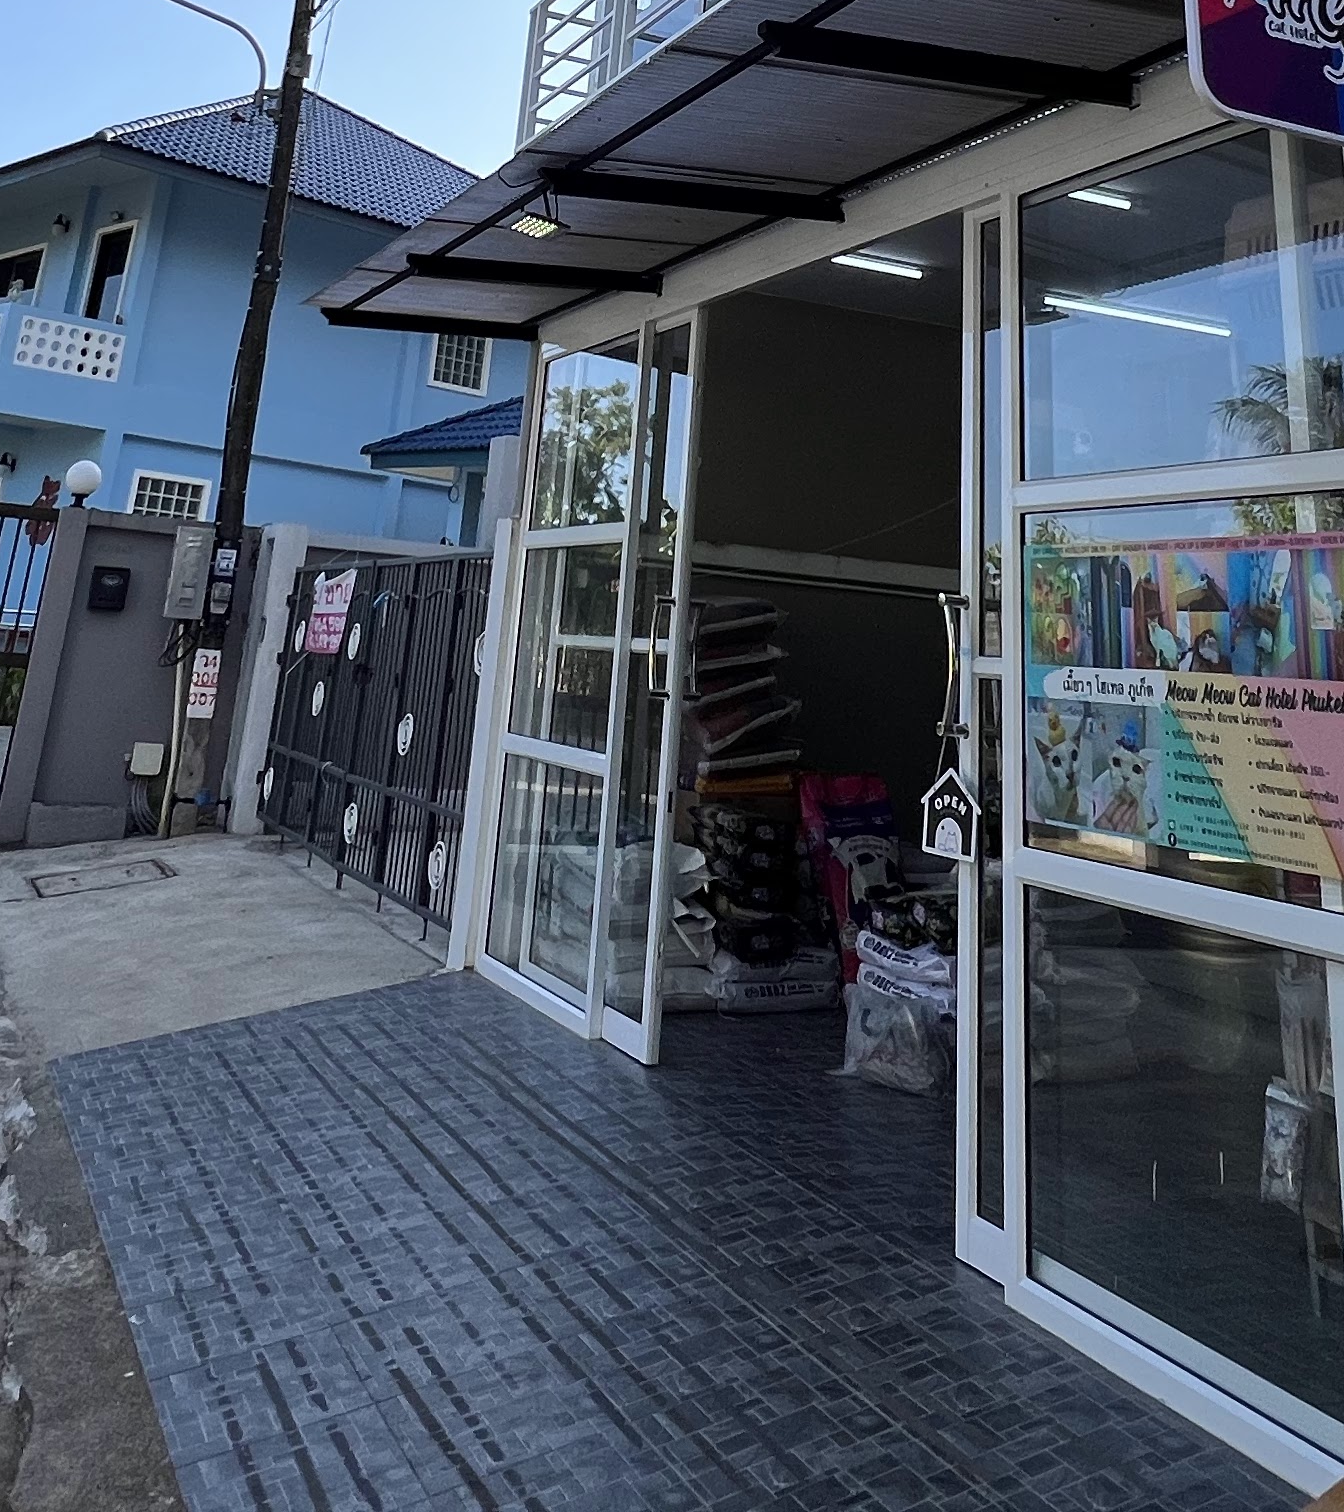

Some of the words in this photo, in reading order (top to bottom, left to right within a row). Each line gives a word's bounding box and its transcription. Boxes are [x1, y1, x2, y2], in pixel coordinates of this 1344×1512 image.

[1165, 679, 1198, 702] Meow
[1201, 682, 1236, 705] Meow
[1239, 684, 1262, 707] Cat
[1265, 686, 1298, 710] Hotel
[934, 794, 967, 816] OPEN
